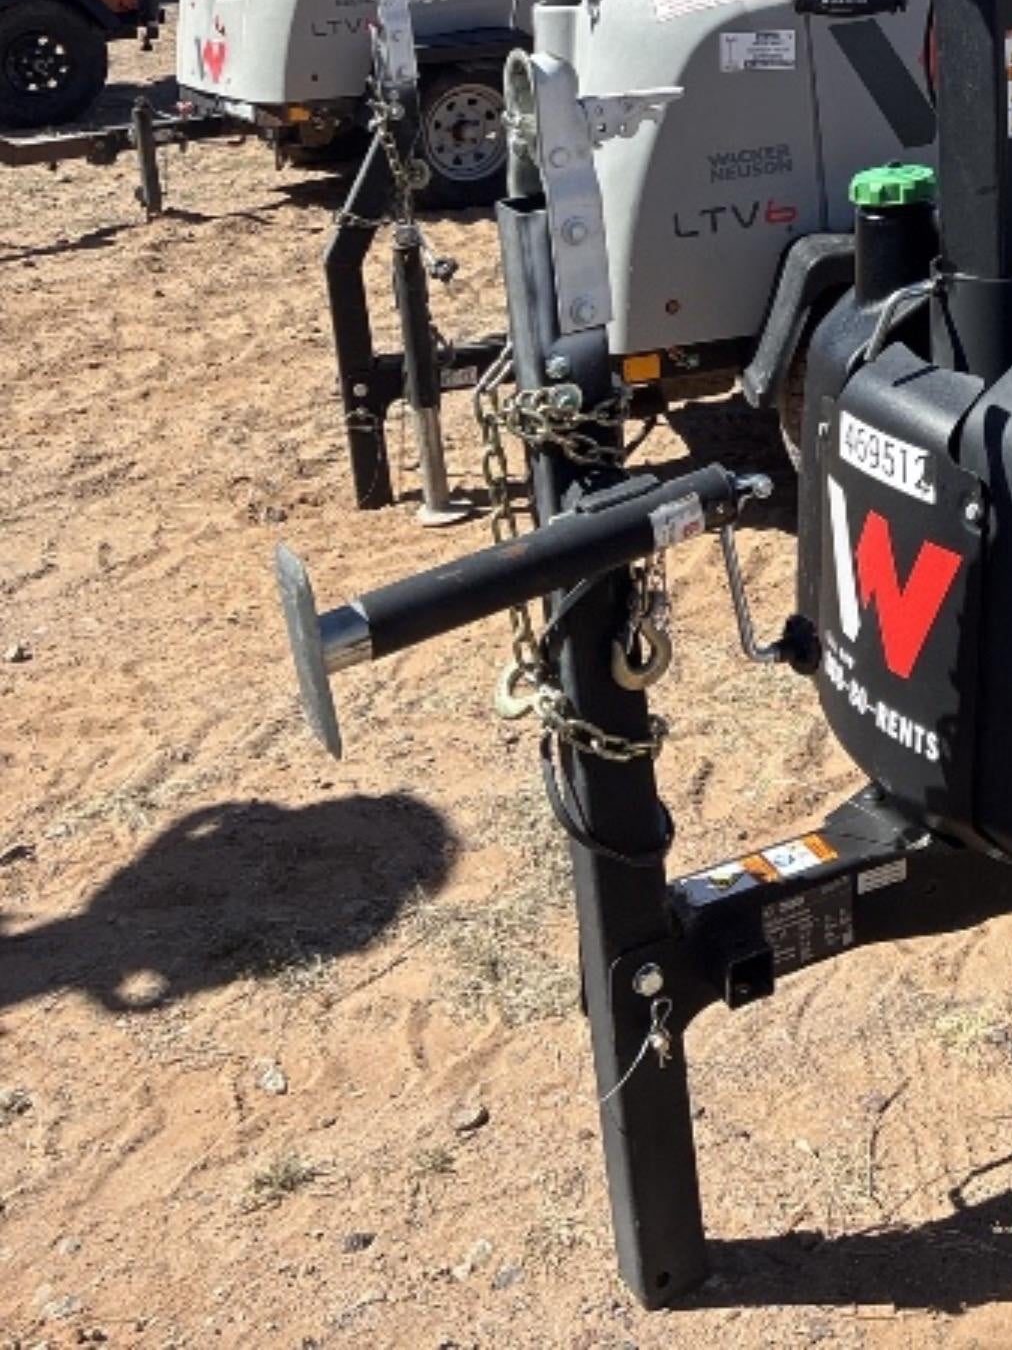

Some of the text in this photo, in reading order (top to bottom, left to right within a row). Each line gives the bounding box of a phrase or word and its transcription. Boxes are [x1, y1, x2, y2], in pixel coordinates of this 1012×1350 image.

[706, 143, 792, 169] WACKER
[709, 158, 793, 184] NEUSON
[672, 199, 798, 238] LTV6
[845, 423, 932, 494] 469512
